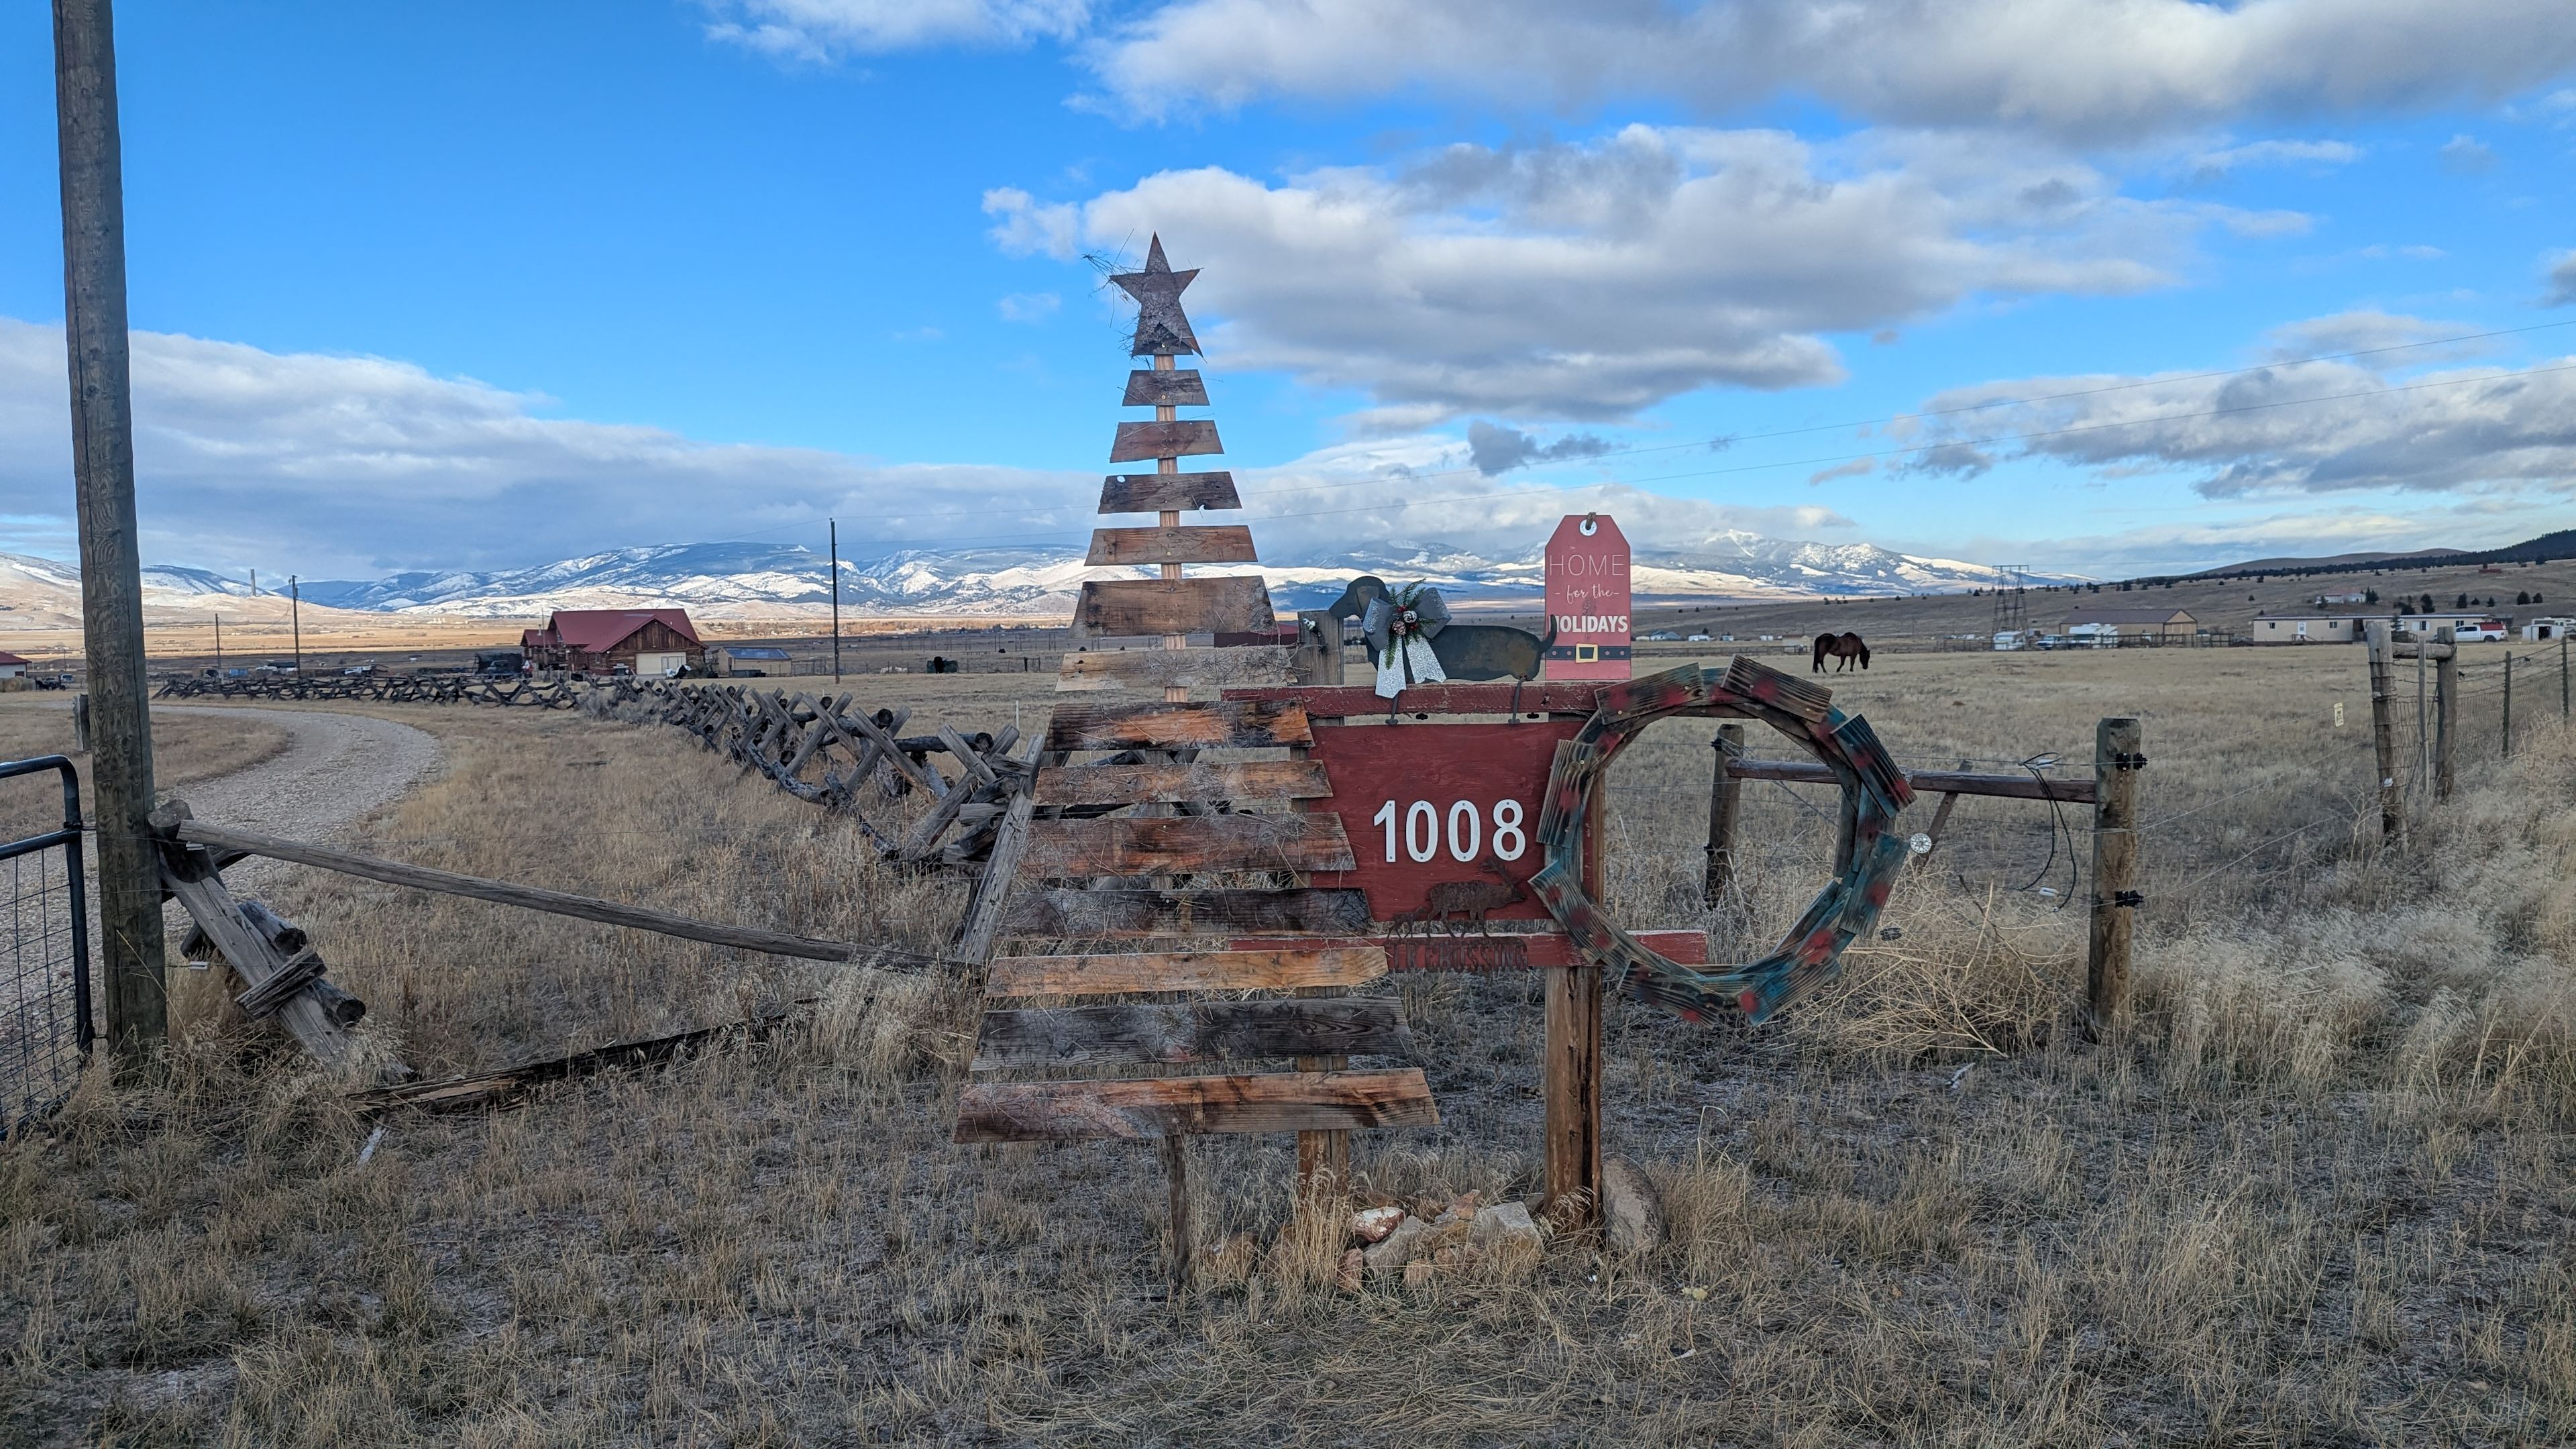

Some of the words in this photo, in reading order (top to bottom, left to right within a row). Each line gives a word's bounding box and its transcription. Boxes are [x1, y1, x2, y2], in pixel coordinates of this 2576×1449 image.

[1549, 554, 1625, 576] HOME
[1566, 584, 1589, 604] for
[1373, 798, 1526, 863] 1008
